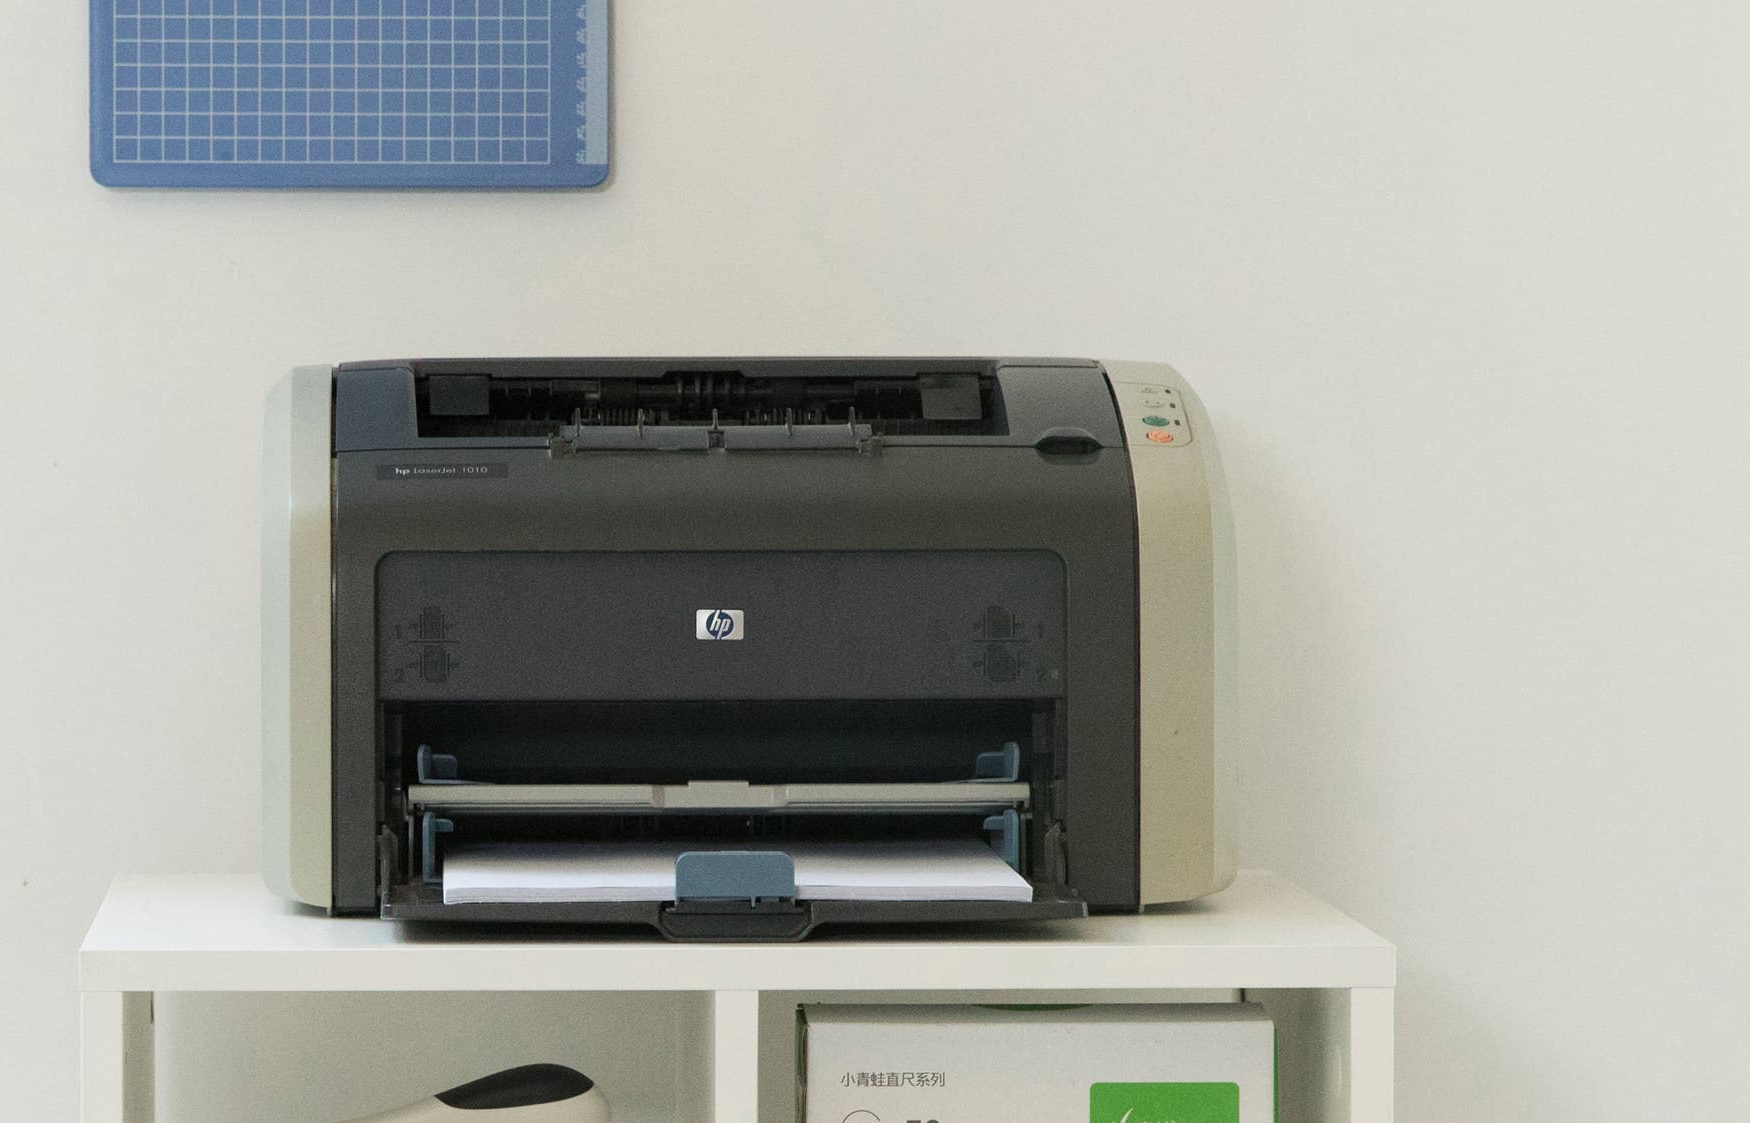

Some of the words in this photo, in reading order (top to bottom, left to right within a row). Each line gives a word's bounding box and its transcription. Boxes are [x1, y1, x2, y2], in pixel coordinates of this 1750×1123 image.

[395, 467, 410, 476] hp
[462, 465, 488, 474] 1010
[840, 1071, 946, 1088] 小青蛙直尺系列
